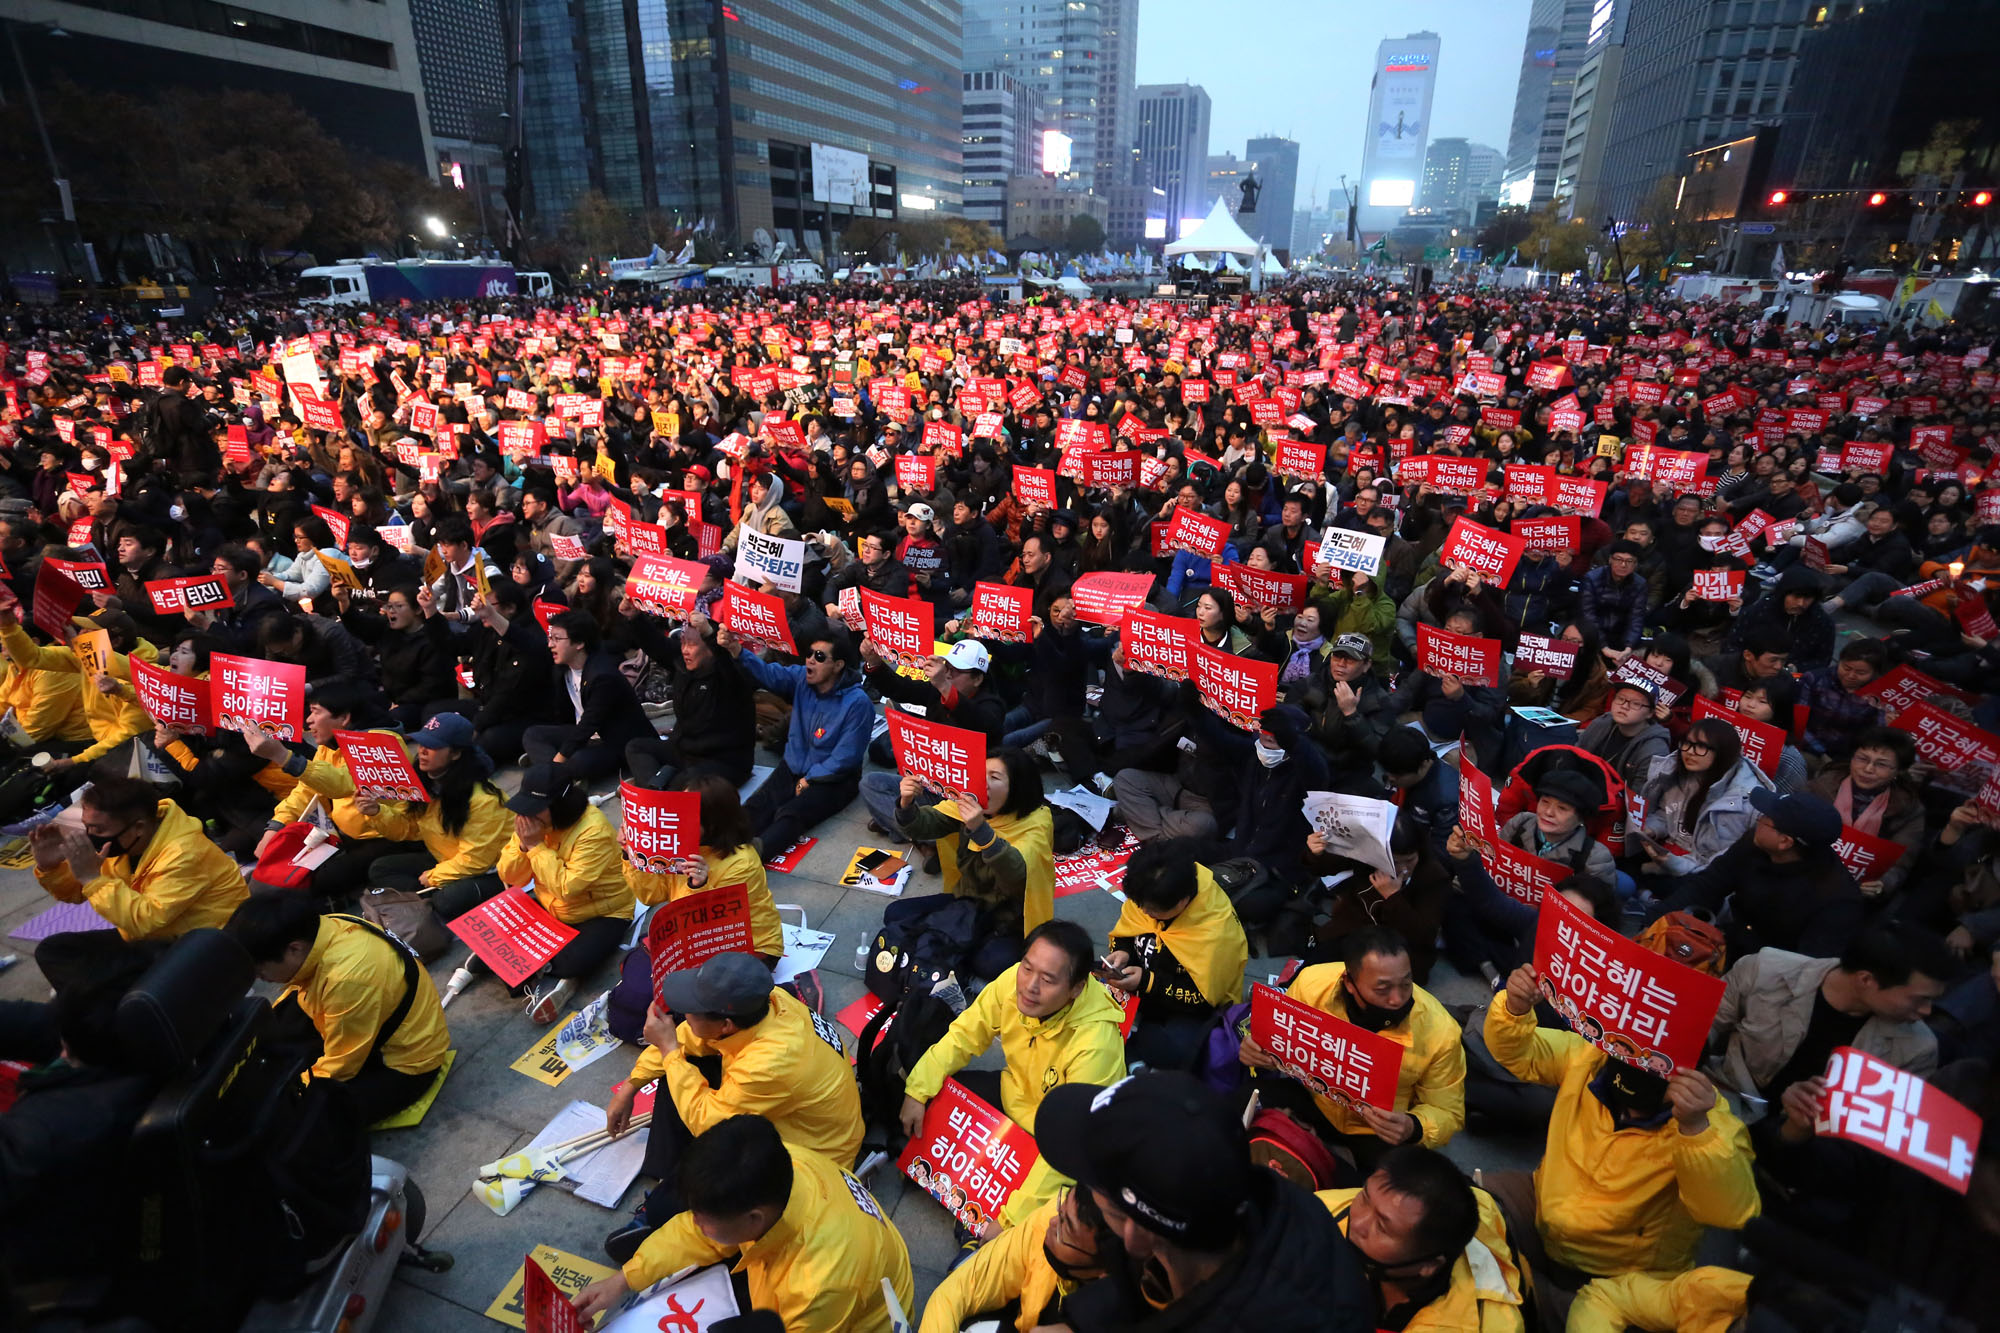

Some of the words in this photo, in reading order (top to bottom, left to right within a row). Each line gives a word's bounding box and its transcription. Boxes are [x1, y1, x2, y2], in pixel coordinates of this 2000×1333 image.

[305, 402, 332, 416] 박근혜는
[1254, 402, 1278, 410] 박근혜는
[1255, 410, 1280, 418] 하야하라
[1554, 412, 1580, 422] 박근혜는
[1794, 414, 1822, 422] 박근혜는
[308, 413, 334, 426] 하야하라
[1792, 420, 1820, 429] 하야하라
[1092, 457, 1133, 470] 박근혜를
[1282, 456, 1316, 470] 하야하라
[1283, 446, 1316, 460] 박근혜는
[1659, 455, 1696, 470] 박근혜는
[1846, 455, 1881, 466] 하야하라
[1848, 448, 1883, 458] 박근혜는
[1018, 472, 1050, 487] 박근혜는
[1092, 469, 1132, 483] 몰아내자
[1436, 473, 1476, 487] 하야하라
[1437, 462, 1478, 476] 박근혜는
[1510, 470, 1544, 484] 박근혜는
[1656, 468, 1695, 482] 하야하라
[1020, 486, 1049, 500] 하야하라
[1509, 482, 1544, 496] 하야하라
[1556, 493, 1594, 508] 하야하라
[1560, 482, 1596, 497] 박근혜는
[1176, 528, 1216, 552] 하야하라
[1180, 516, 1220, 540] 박근혜는
[1522, 526, 1570, 538] 박근혜는
[748, 532, 785, 558] 박근혜
[1331, 531, 1366, 552] 박근혜
[1460, 528, 1508, 556] 박근혜는
[744, 550, 800, 579] 즉각퇴진
[1324, 547, 1376, 573] 즉각퇴진
[1452, 544, 1504, 574] 하야하라
[75, 570, 104, 589] 퇴진!
[642, 562, 691, 588] 박근혜는
[1240, 572, 1294, 594] 박근혜를
[1694, 572, 1728, 586] 이게
[187, 582, 223, 606] 퇴진!
[636, 582, 685, 606] 하야하라
[980, 592, 1021, 612] 박근혜는
[1693, 584, 1743, 600] 나라냐
[730, 594, 776, 624] 박근혜는
[869, 602, 920, 632] 박근혜는
[976, 610, 1020, 630] 하야하라
[730, 614, 782, 640] 하야하라
[872, 624, 921, 652] 하야하라
[1130, 620, 1186, 648] 박근혜는
[952, 643, 965, 656] T
[1130, 640, 1188, 668] 하야하라
[1427, 636, 1486, 662] 박근혜는
[1519, 634, 1550, 650] 박근혜
[1426, 650, 1485, 676] 하야하라
[1515, 646, 1534, 663] 즉각
[1535, 650, 1574, 668] 완전퇴진!
[222, 668, 288, 698] 박근혜는
[1196, 653, 1259, 693] 박근혜는
[1624, 658, 1669, 686] 새누리당
[137, 670, 198, 706] 박근혜는
[1199, 674, 1258, 714] 하야하라
[140, 689, 198, 723] 하야하라
[222, 692, 288, 721] 하야하라
[900, 726, 968, 766] 박근혜는
[1918, 716, 1999, 762] 박근혜는
[348, 743, 401, 764] 박근혜는
[355, 765, 411, 785] 하야하라
[903, 750, 970, 790] 하야하라
[622, 799, 680, 830] 근혜는
[624, 826, 680, 855] 야하라
[680, 908, 708, 929] 7대
[711, 899, 742, 921] 요구
[1548, 890, 1568, 913] 나눔문화
[1568, 910, 1614, 945] www.nanum.com
[1557, 919, 1678, 1014] 박근혜는
[1549, 952, 1670, 1047] 하야하라
[1272, 1008, 1374, 1073] 박근혜는
[1270, 1032, 1371, 1099] 하야하라
[1826, 1052, 1924, 1116] 이게
[948, 1106, 1021, 1182] 박근혜는
[1814, 1090, 1975, 1181] 나라냐
[930, 1136, 1006, 1212] 하야하라
[551, 1264, 592, 1291] 박근혜
